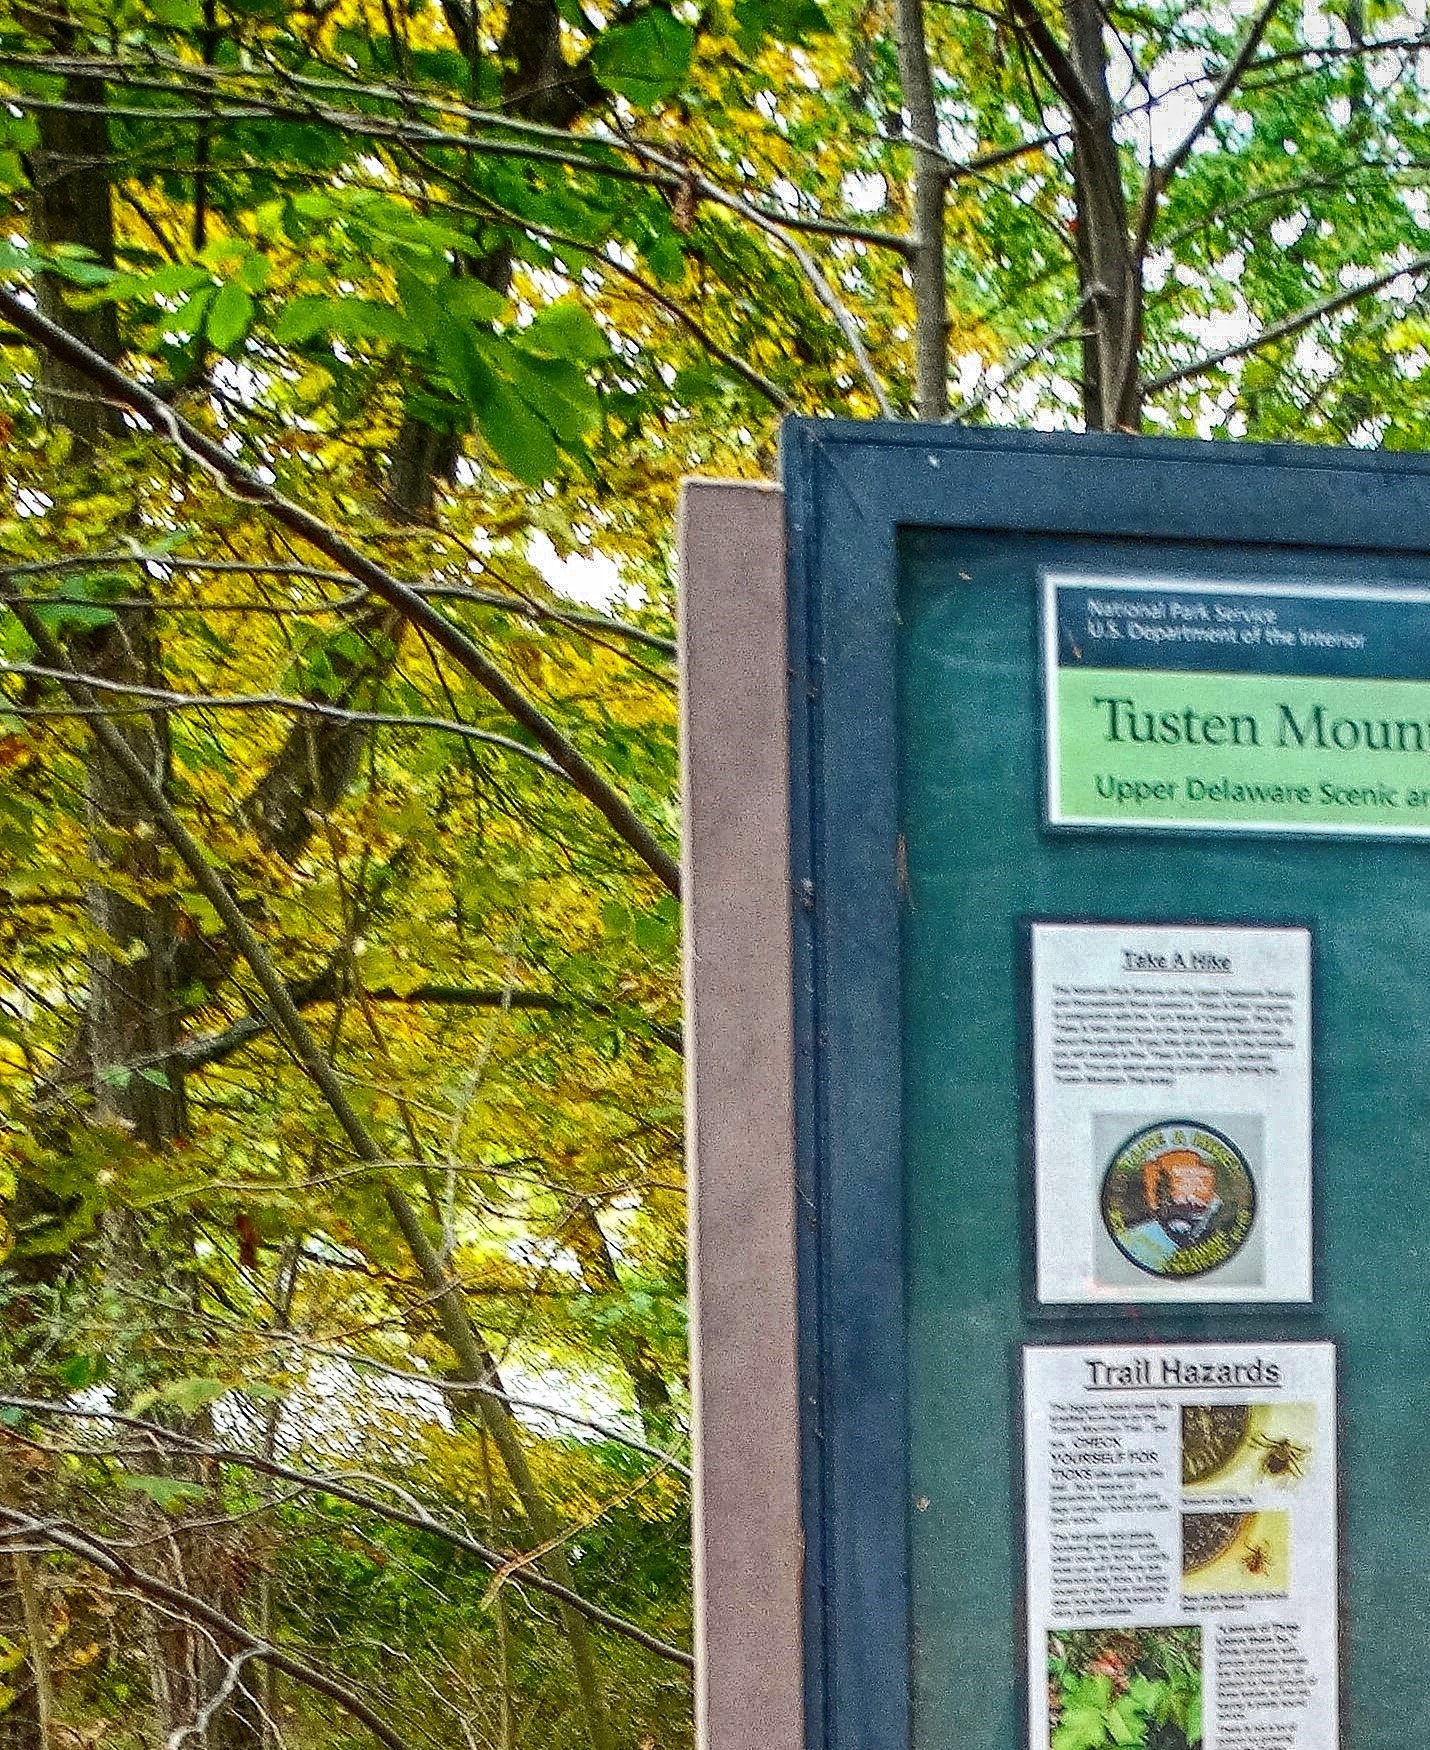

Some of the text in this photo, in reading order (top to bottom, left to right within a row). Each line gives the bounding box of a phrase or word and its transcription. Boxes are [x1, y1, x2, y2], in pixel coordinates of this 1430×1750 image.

[1087, 600, 1278, 623] National Park Service
[1088, 620, 1367, 649] U.S. Department of the Interior
[1094, 697, 1261, 747] Tusten
[1096, 775, 1178, 806] Upper
[1185, 777, 1313, 806] Delaware
[1319, 782, 1399, 808] Scenic
[1122, 949, 1233, 970] Take A Hike
[1086, 1359, 1282, 1386] Trail Hazards
